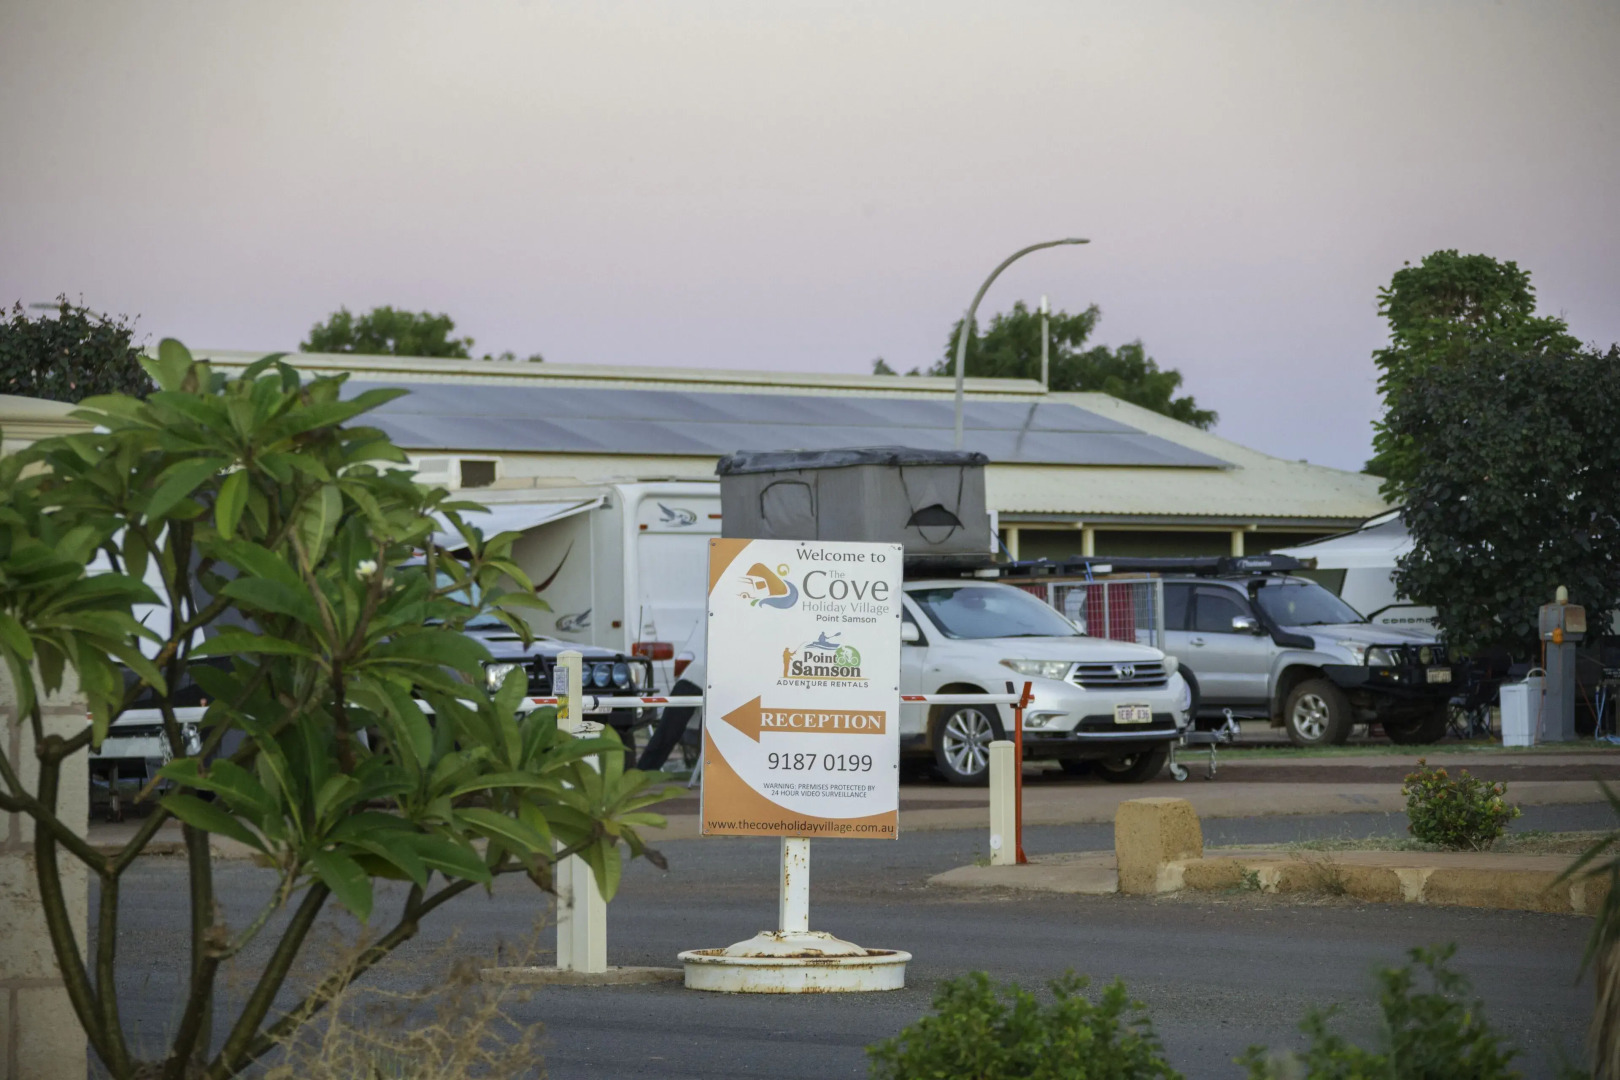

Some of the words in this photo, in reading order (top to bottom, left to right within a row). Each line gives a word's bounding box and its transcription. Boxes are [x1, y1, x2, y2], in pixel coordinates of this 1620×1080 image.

[796, 548, 865, 563] Welcome
[870, 552, 886, 563] to
[828, 570, 845, 579] The
[802, 570, 889, 601] Cove
[802, 601, 846, 614] Holiday
[850, 602, 889, 615] Village
[816, 614, 839, 623] Point
[842, 615, 877, 623] Samson
[803, 651, 837, 664] Point
[791, 660, 861, 677] Samson
[776, 679, 828, 687] ADVENTURE
[830, 680, 869, 688] RENTALS
[760, 712, 882, 729] RECEPTION
[767, 752, 817, 770] 9187
[823, 754, 873, 772] 0199
[798, 783, 829, 791] PREMISES
[821, 790, 867, 798] SURVEILLANCE
[708, 819, 894, 834] www.thecoveholidayvillage.com.au
